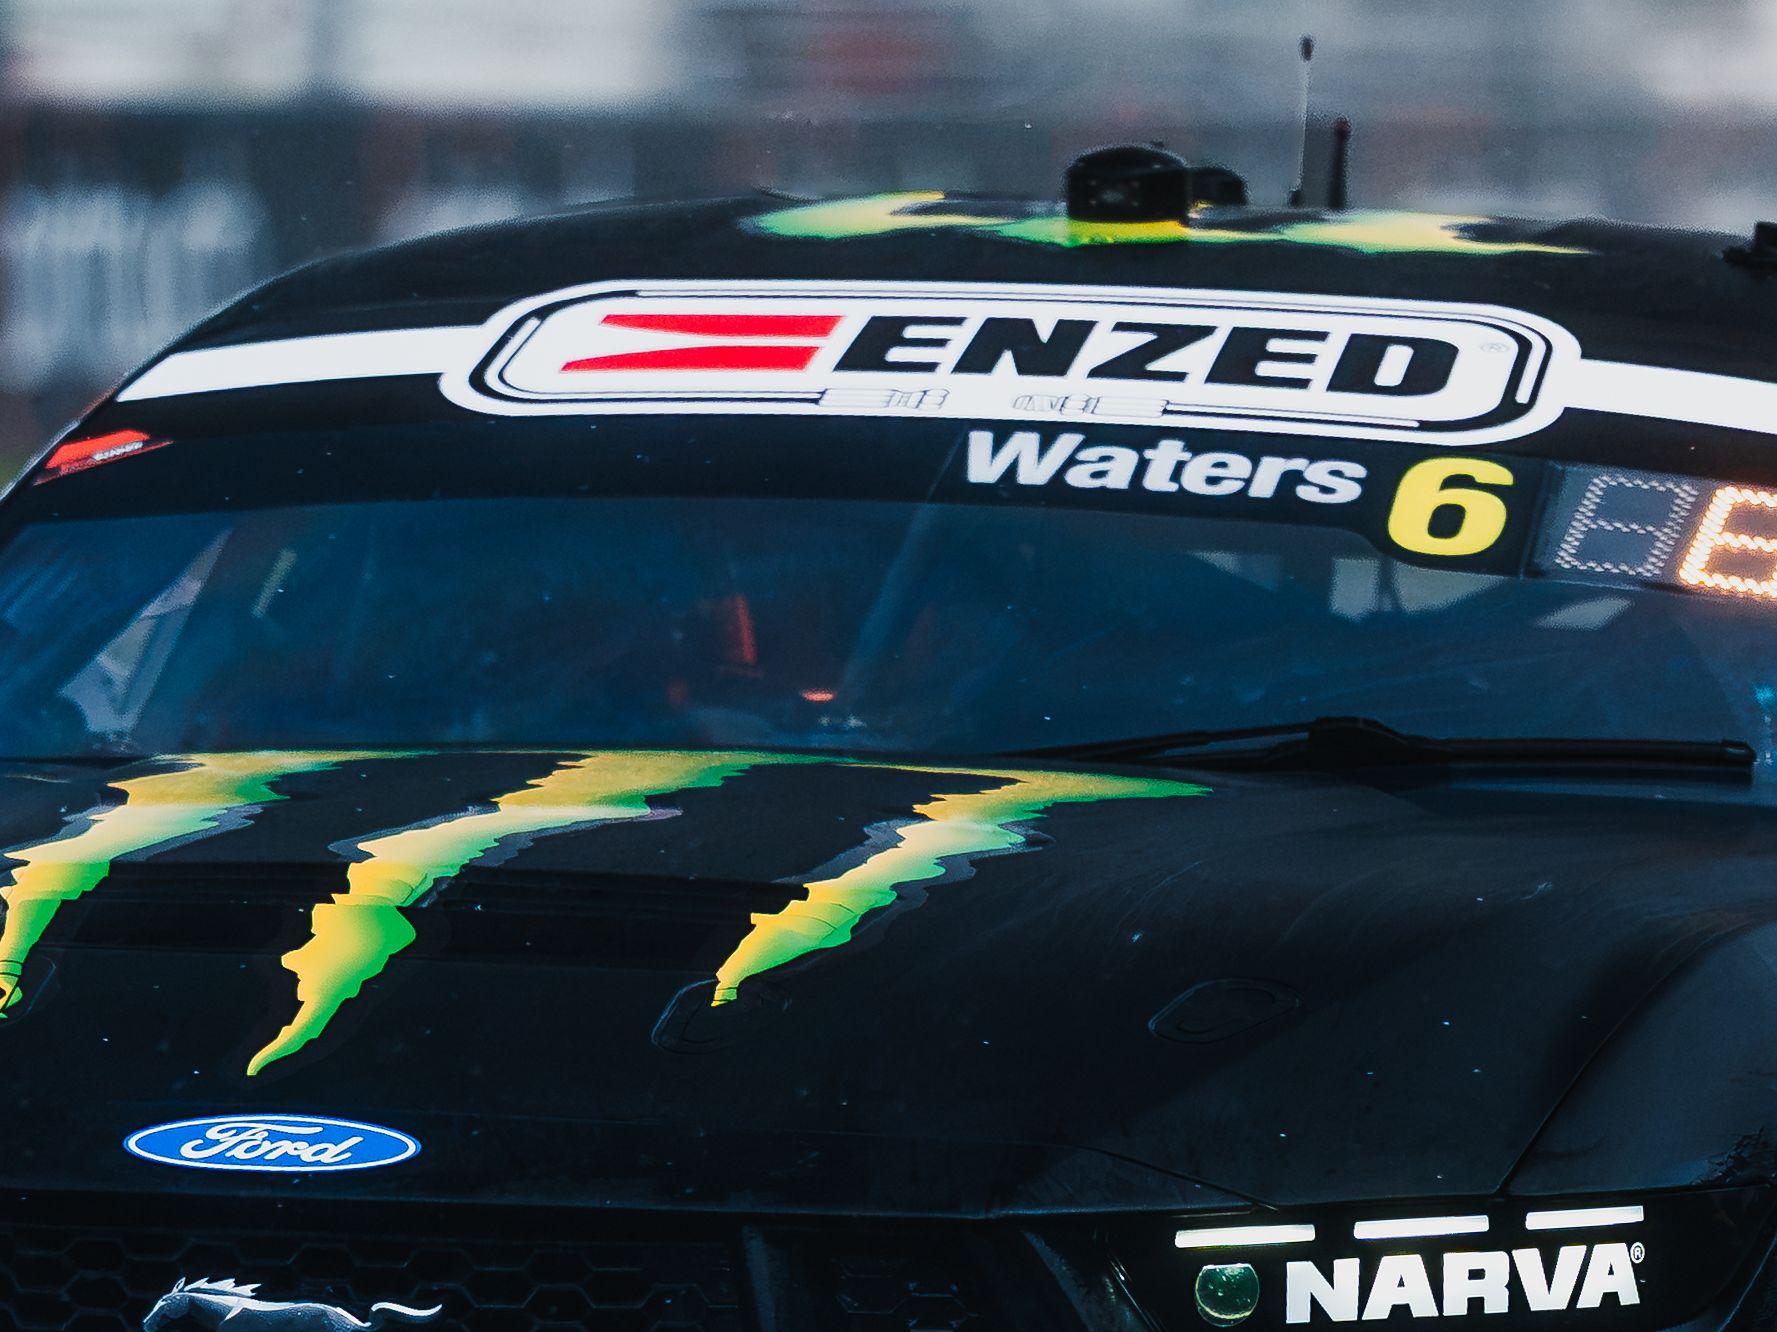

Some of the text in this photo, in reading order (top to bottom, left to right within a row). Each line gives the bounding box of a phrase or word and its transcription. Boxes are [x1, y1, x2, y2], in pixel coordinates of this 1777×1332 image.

[832, 314, 1460, 397] ENZED
[966, 430, 1515, 558] Waters 6
[179, 1121, 365, 1163] Ford
